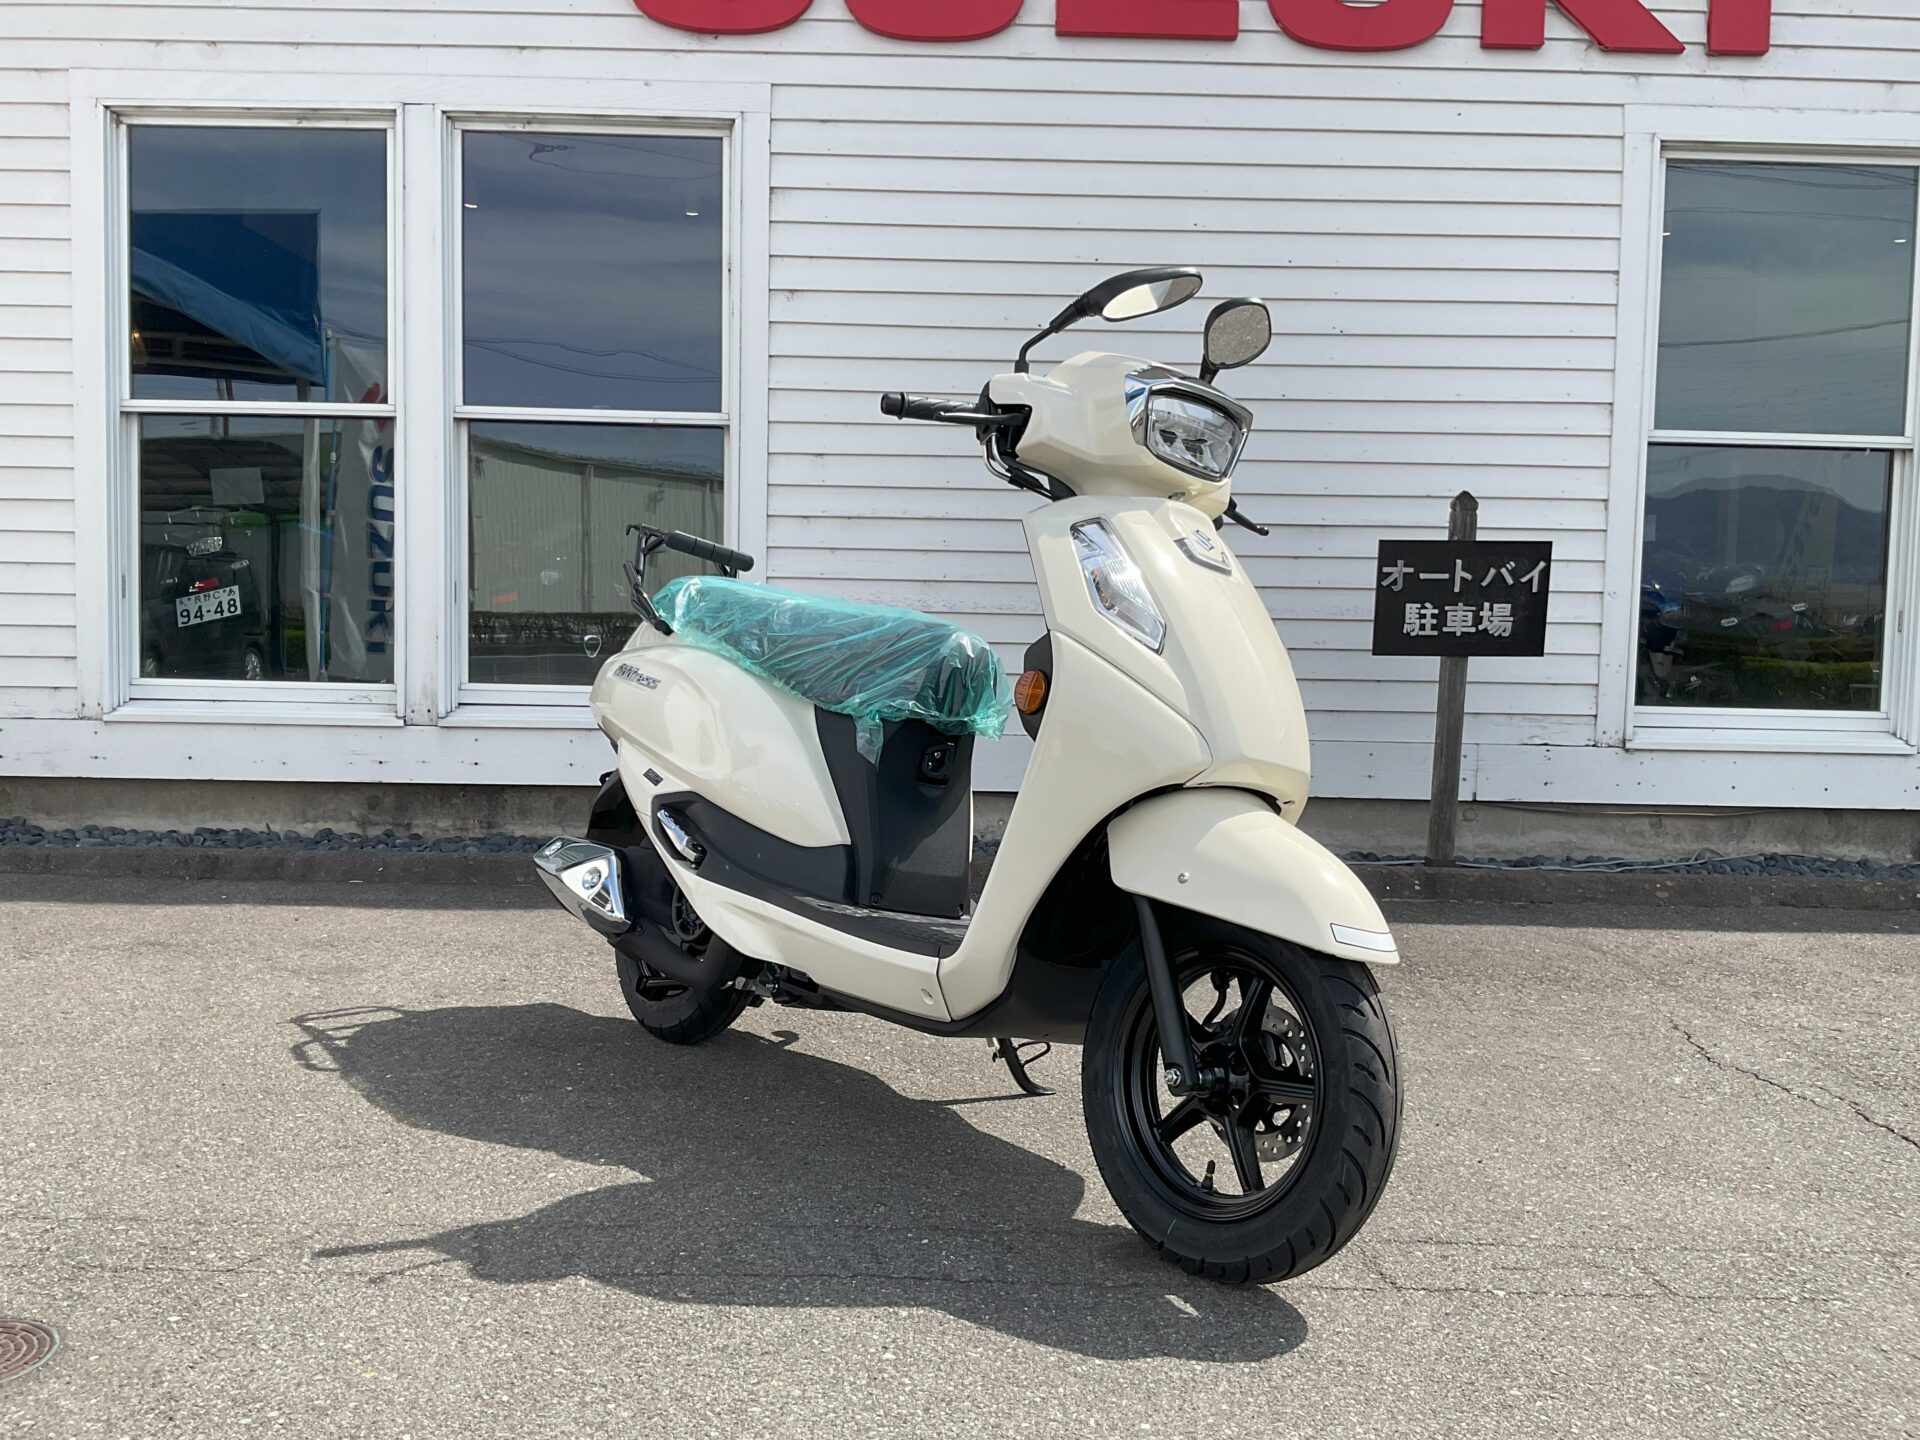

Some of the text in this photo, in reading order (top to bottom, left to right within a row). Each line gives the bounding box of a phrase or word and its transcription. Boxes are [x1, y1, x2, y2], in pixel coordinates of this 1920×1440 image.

[1381, 559, 1547, 593] オートバイ
[180, 598, 238, 625] 94-48
[1403, 602, 1514, 637] 駐車場
